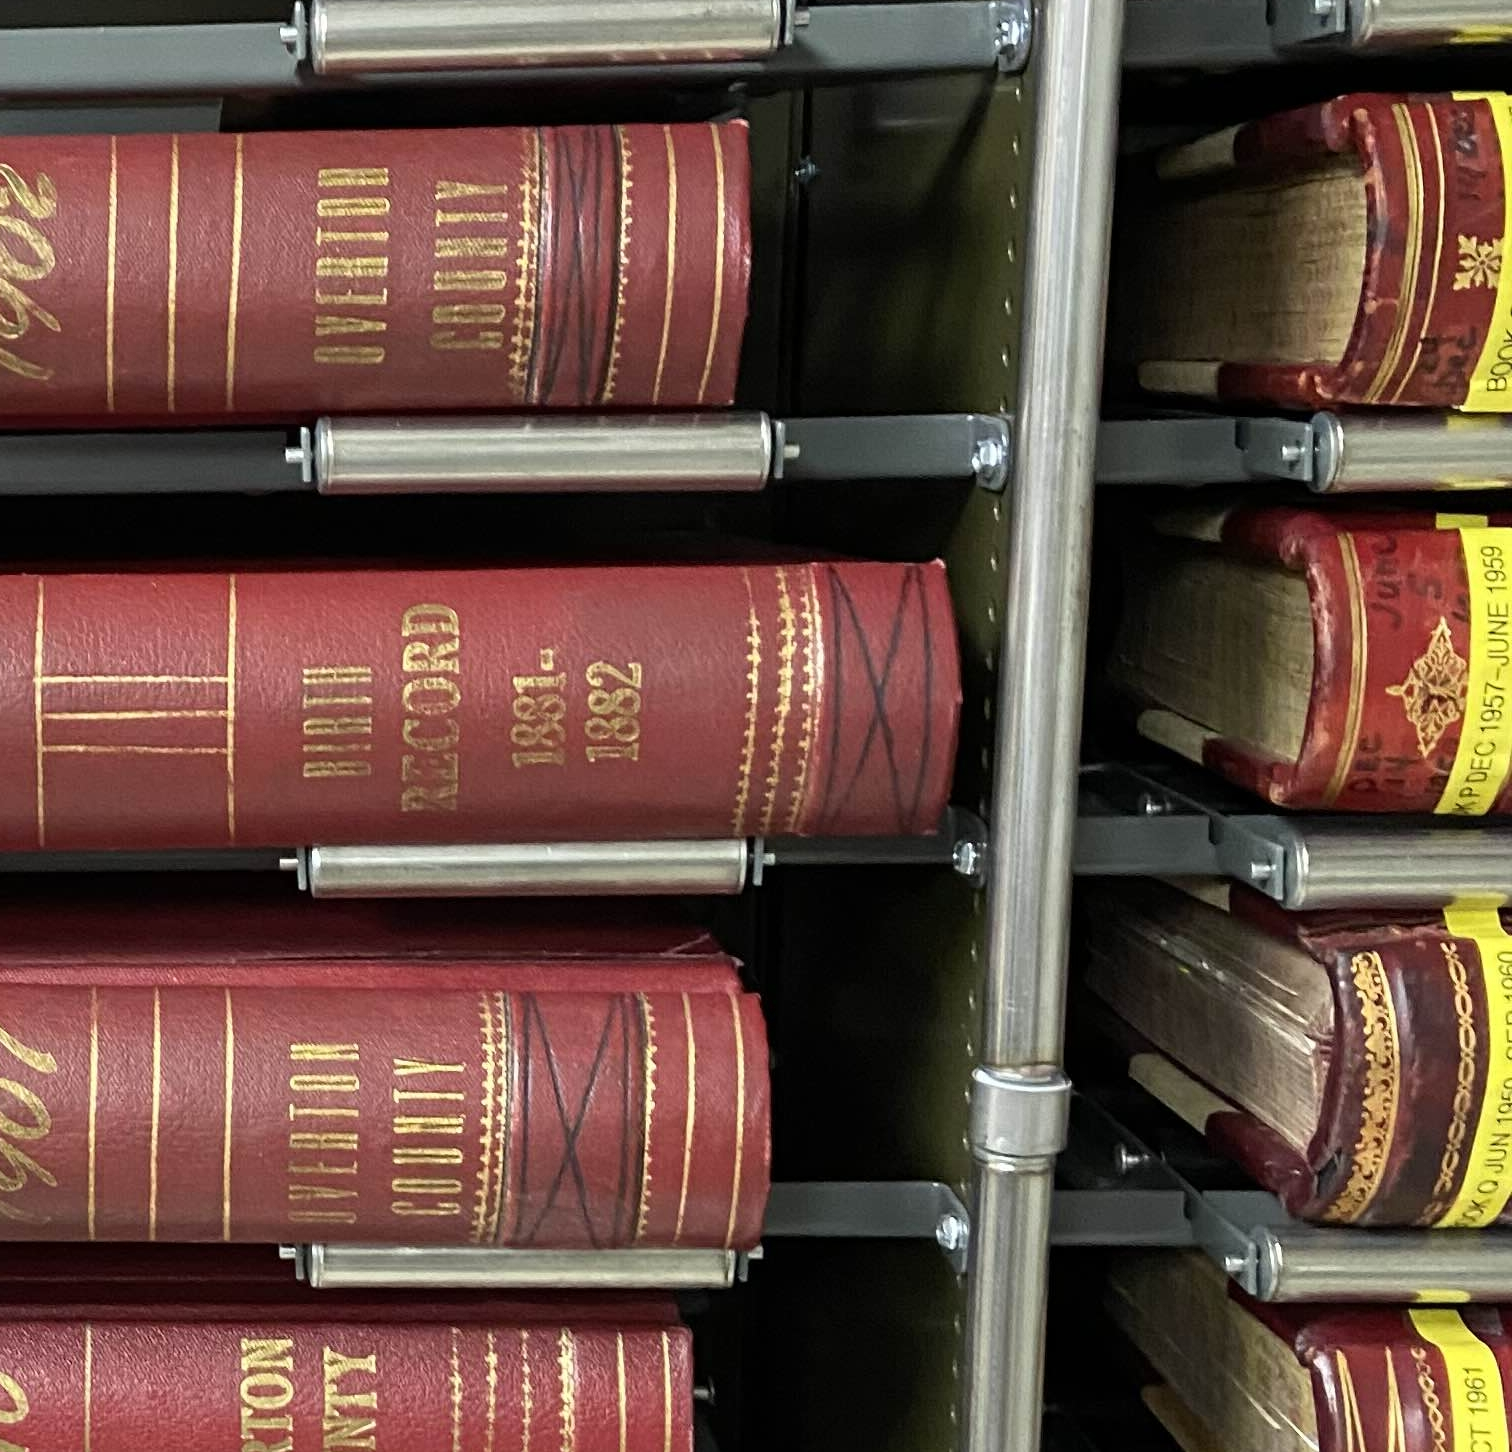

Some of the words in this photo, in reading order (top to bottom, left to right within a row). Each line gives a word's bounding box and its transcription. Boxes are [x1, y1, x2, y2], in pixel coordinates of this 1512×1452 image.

[314, 167, 389, 365] OVERTON
[430, 180, 508, 350] COUNTY
[1480, 545, 1505, 594] 1959
[301, 665, 374, 779] BIRTH
[400, 602, 461, 814] RECORD
[511, 648, 568, 769] 1881-
[585, 661, 641, 764] 1882
[1465, 741, 1496, 783] DEC
[288, 1042, 359, 1225] OVERTON
[391, 1058, 466, 1215] COUNTY
[1484, 1132, 1510, 1174] JUN
[1464, 1367, 1488, 1416] 1961
